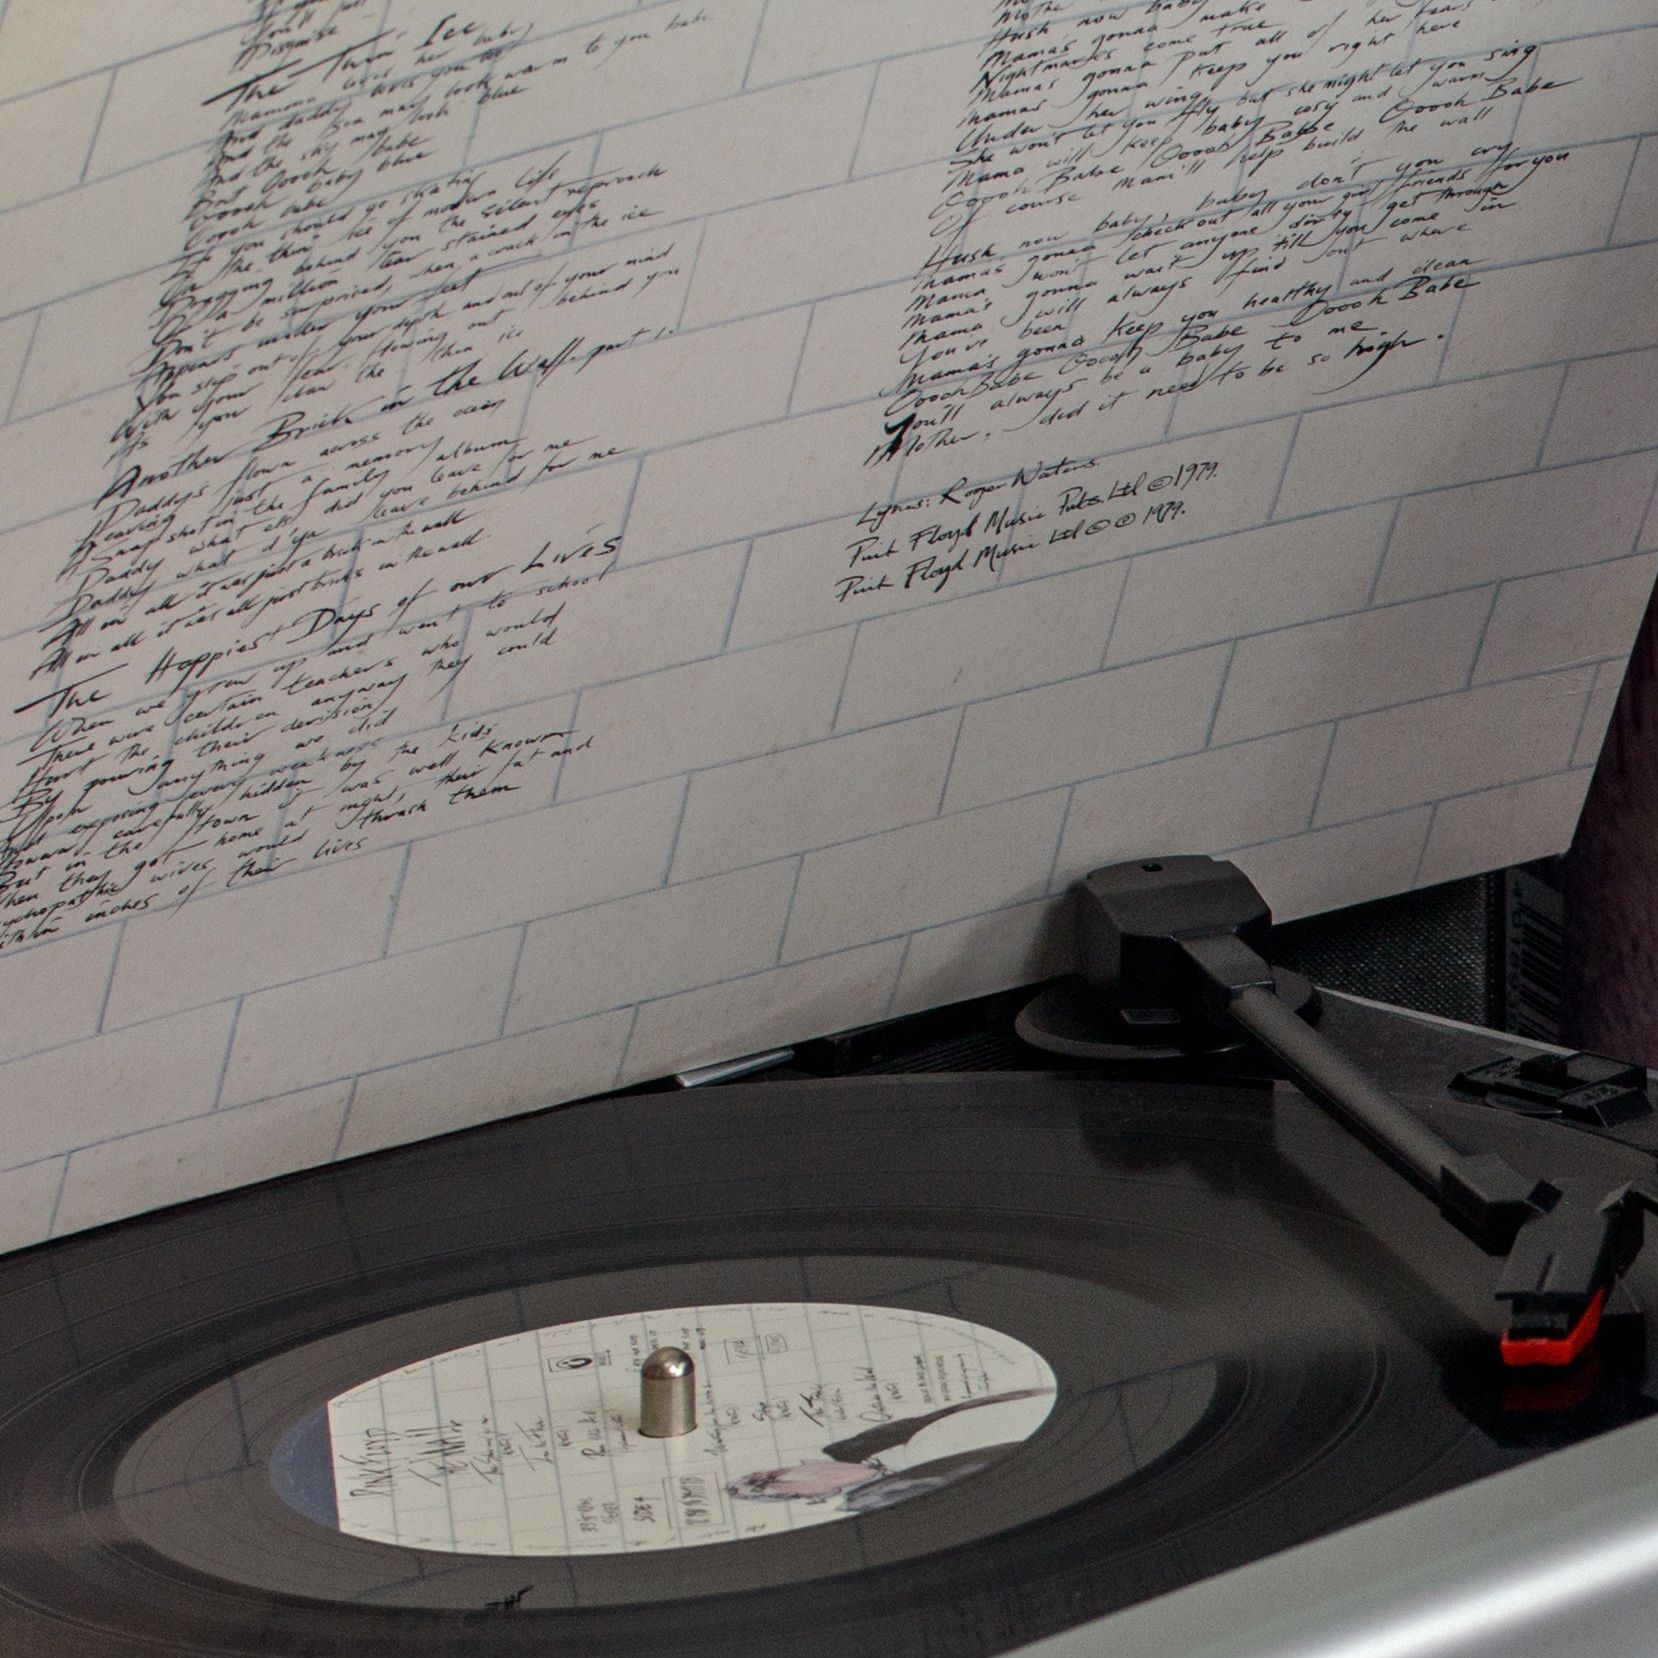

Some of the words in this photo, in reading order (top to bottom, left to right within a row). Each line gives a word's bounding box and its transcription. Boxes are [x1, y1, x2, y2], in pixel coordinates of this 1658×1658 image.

[412, 13, 478, 50] Ice
[1259, 359, 1284, 377] be
[99, 447, 238, 502] Another
[252, 410, 354, 452] Brick
[432, 365, 480, 399] the
[909, 515, 974, 551] Floyd
[984, 509, 1047, 535] Music
[904, 555, 964, 592] Floyd
[974, 543, 1039, 571] Music
[14, 664, 128, 720] The
[289, 602, 375, 643] Days
[395, 578, 432, 613] of
